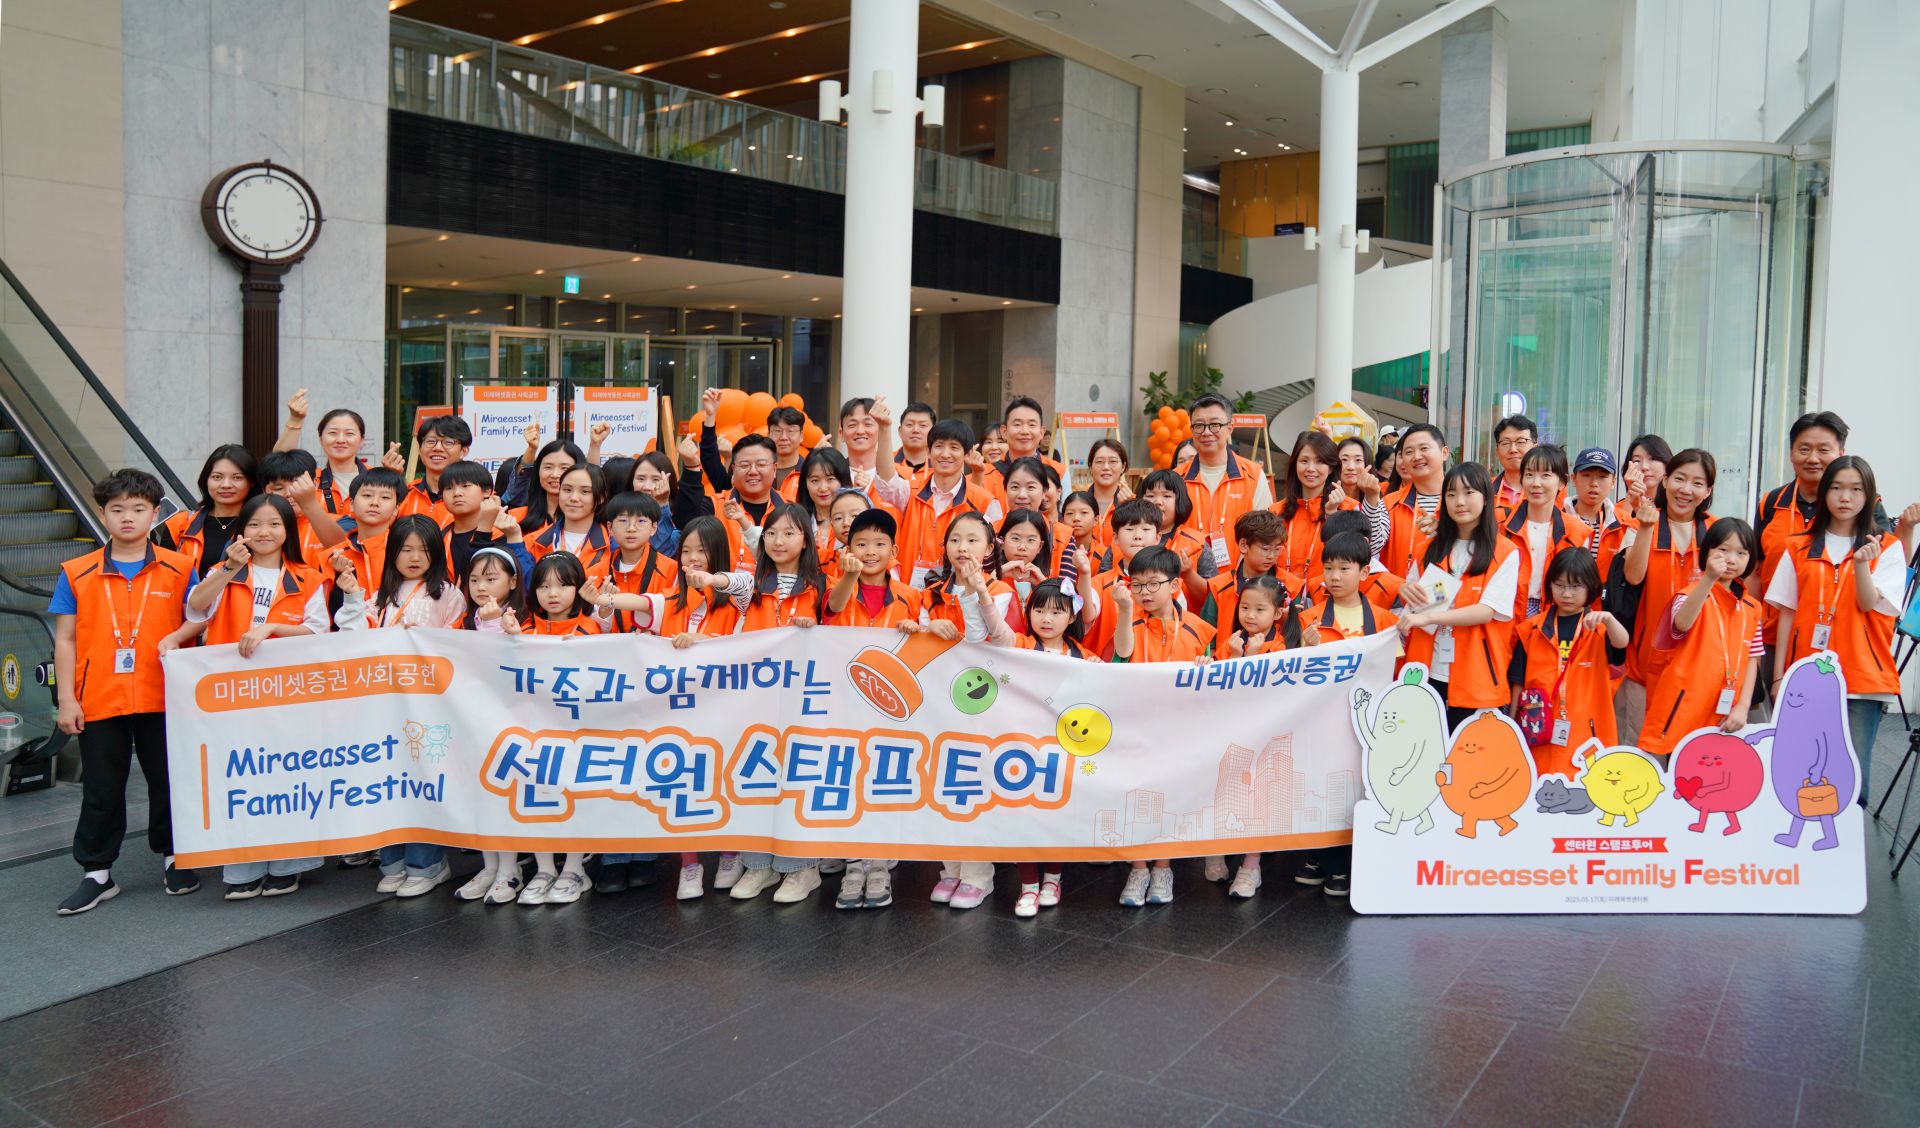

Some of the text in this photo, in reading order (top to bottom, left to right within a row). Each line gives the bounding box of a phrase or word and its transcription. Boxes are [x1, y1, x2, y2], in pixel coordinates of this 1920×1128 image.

[481, 414, 532, 423] Miraeasset
[481, 426, 511, 437] Family
[590, 413, 635, 422] Miraeasset
[617, 424, 647, 433] Festival
[214, 662, 436, 703] 미래에셋증권 사회공헌
[500, 658, 832, 721] 가족과 함께하는
[1174, 653, 1363, 691] 미래에셋증권
[226, 734, 399, 778] Miraeasset
[227, 772, 445, 820] Family Festival
[495, 739, 1060, 818] 센터원 스탬프 투어
[1564, 839, 1653, 851] 센터원 스탬프투어
[1417, 858, 1799, 890] Miraeasset Family Festival
